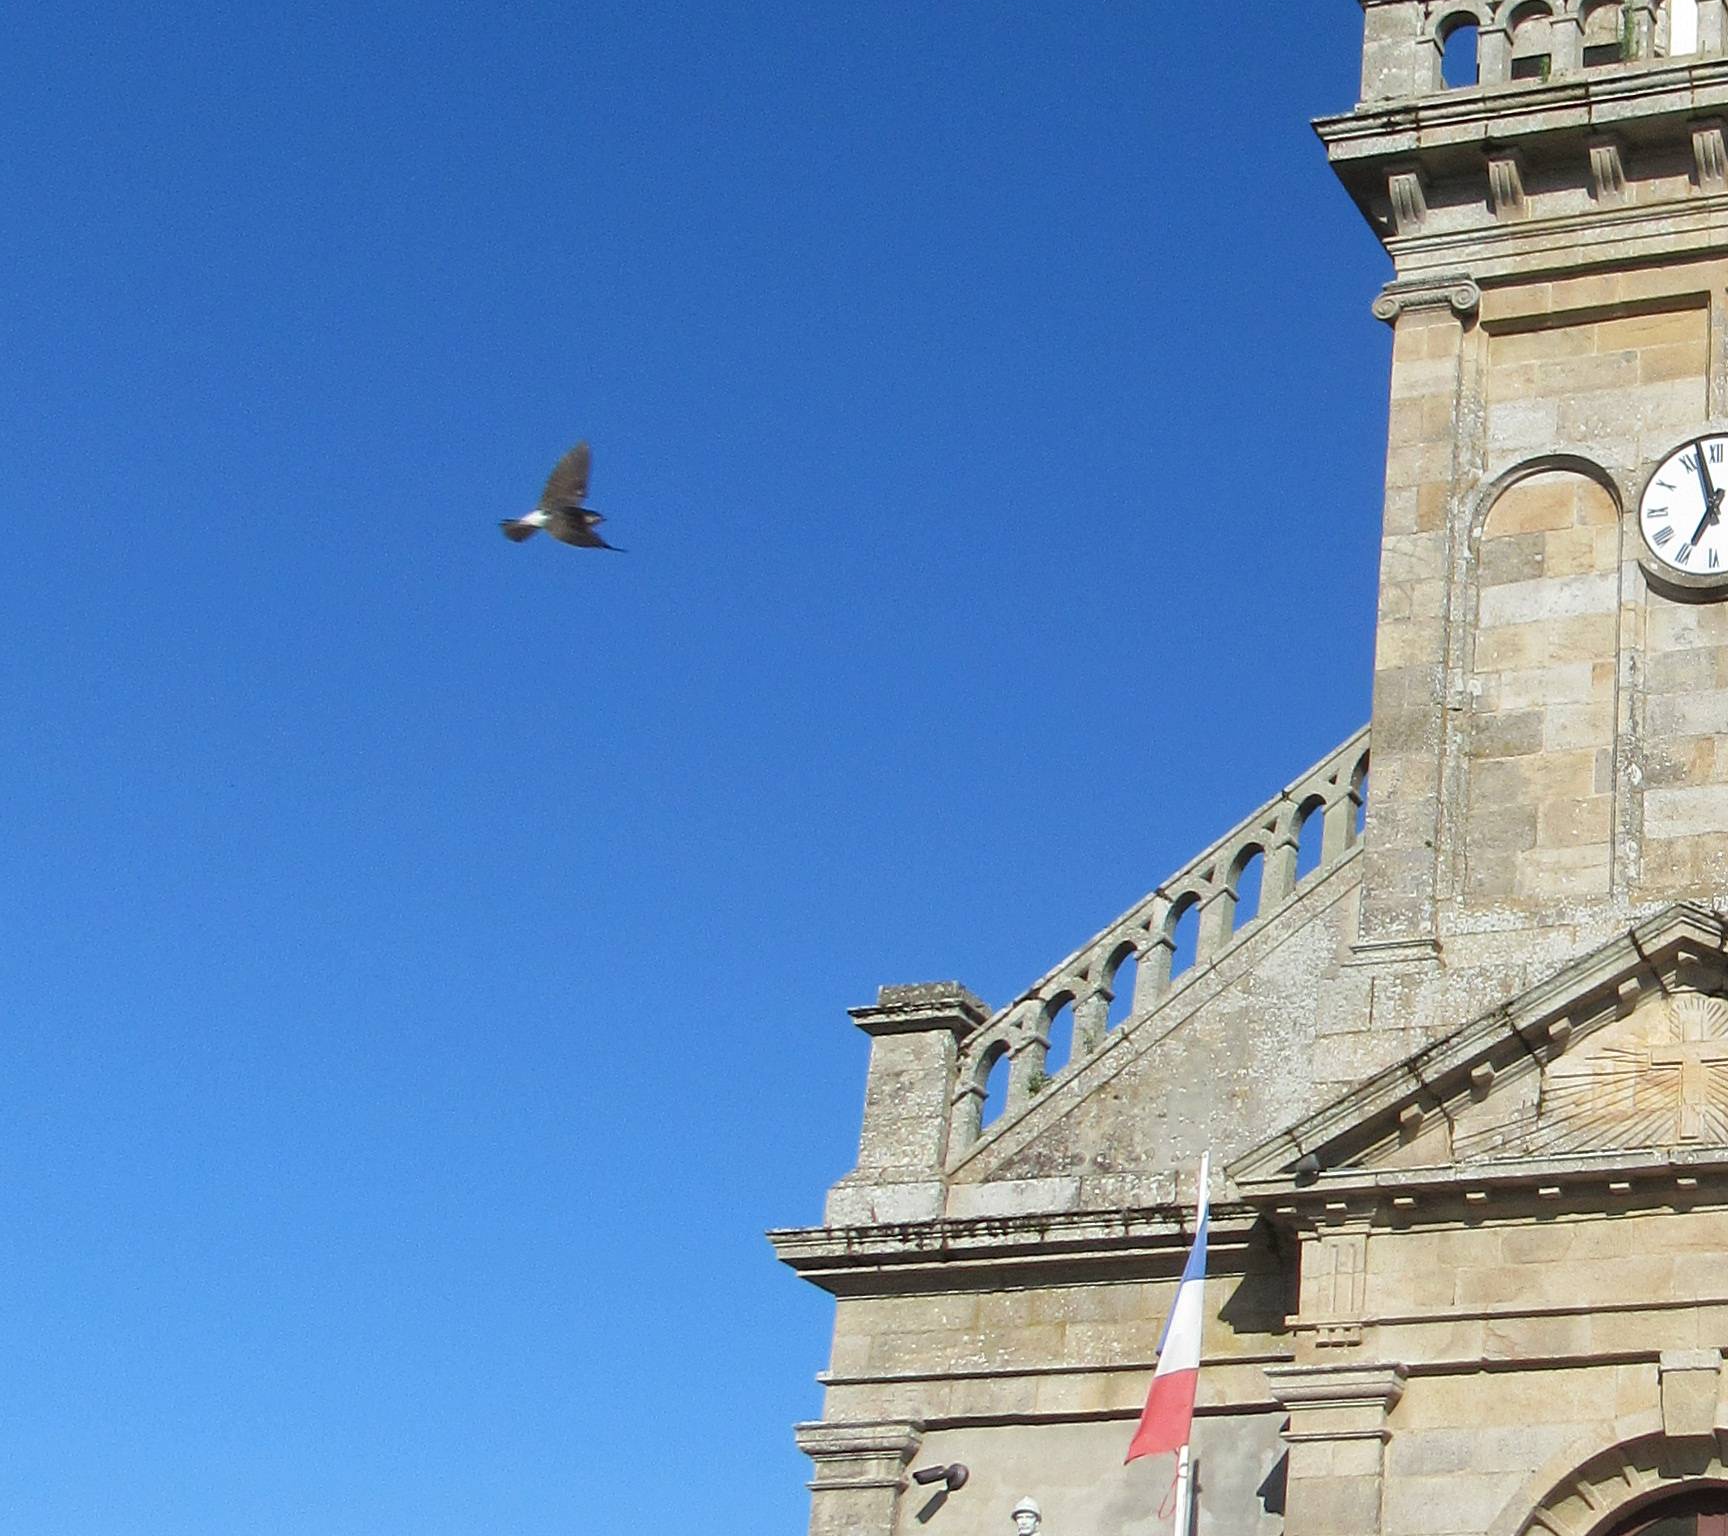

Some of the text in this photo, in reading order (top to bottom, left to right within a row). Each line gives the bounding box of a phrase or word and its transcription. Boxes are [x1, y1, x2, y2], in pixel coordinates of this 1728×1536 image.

[1709, 443, 1724, 464] XII
[1655, 478, 1677, 492] X
[1646, 506, 1669, 519] IX
[1708, 547, 1720, 569] VI
